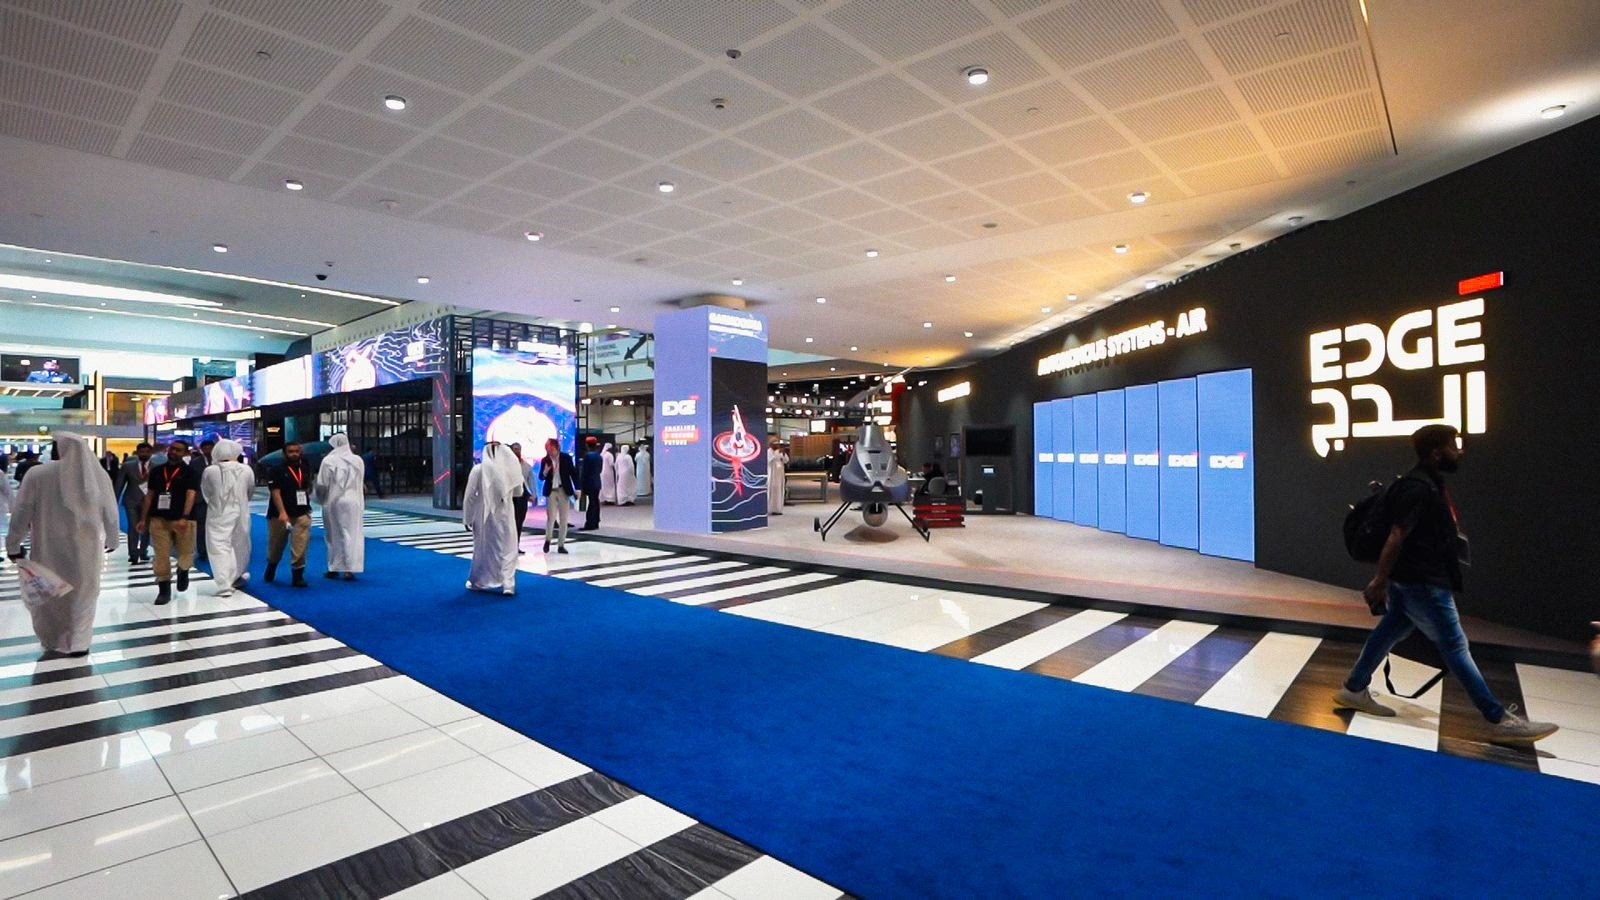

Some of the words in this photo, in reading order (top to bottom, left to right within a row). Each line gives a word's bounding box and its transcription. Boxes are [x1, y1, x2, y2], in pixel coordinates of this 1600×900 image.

[1107, 320, 1166, 357] SYSTEMS
[1176, 308, 1208, 338] AIR
[1309, 297, 1486, 384] EDGE
[661, 400, 696, 416] EDGE
